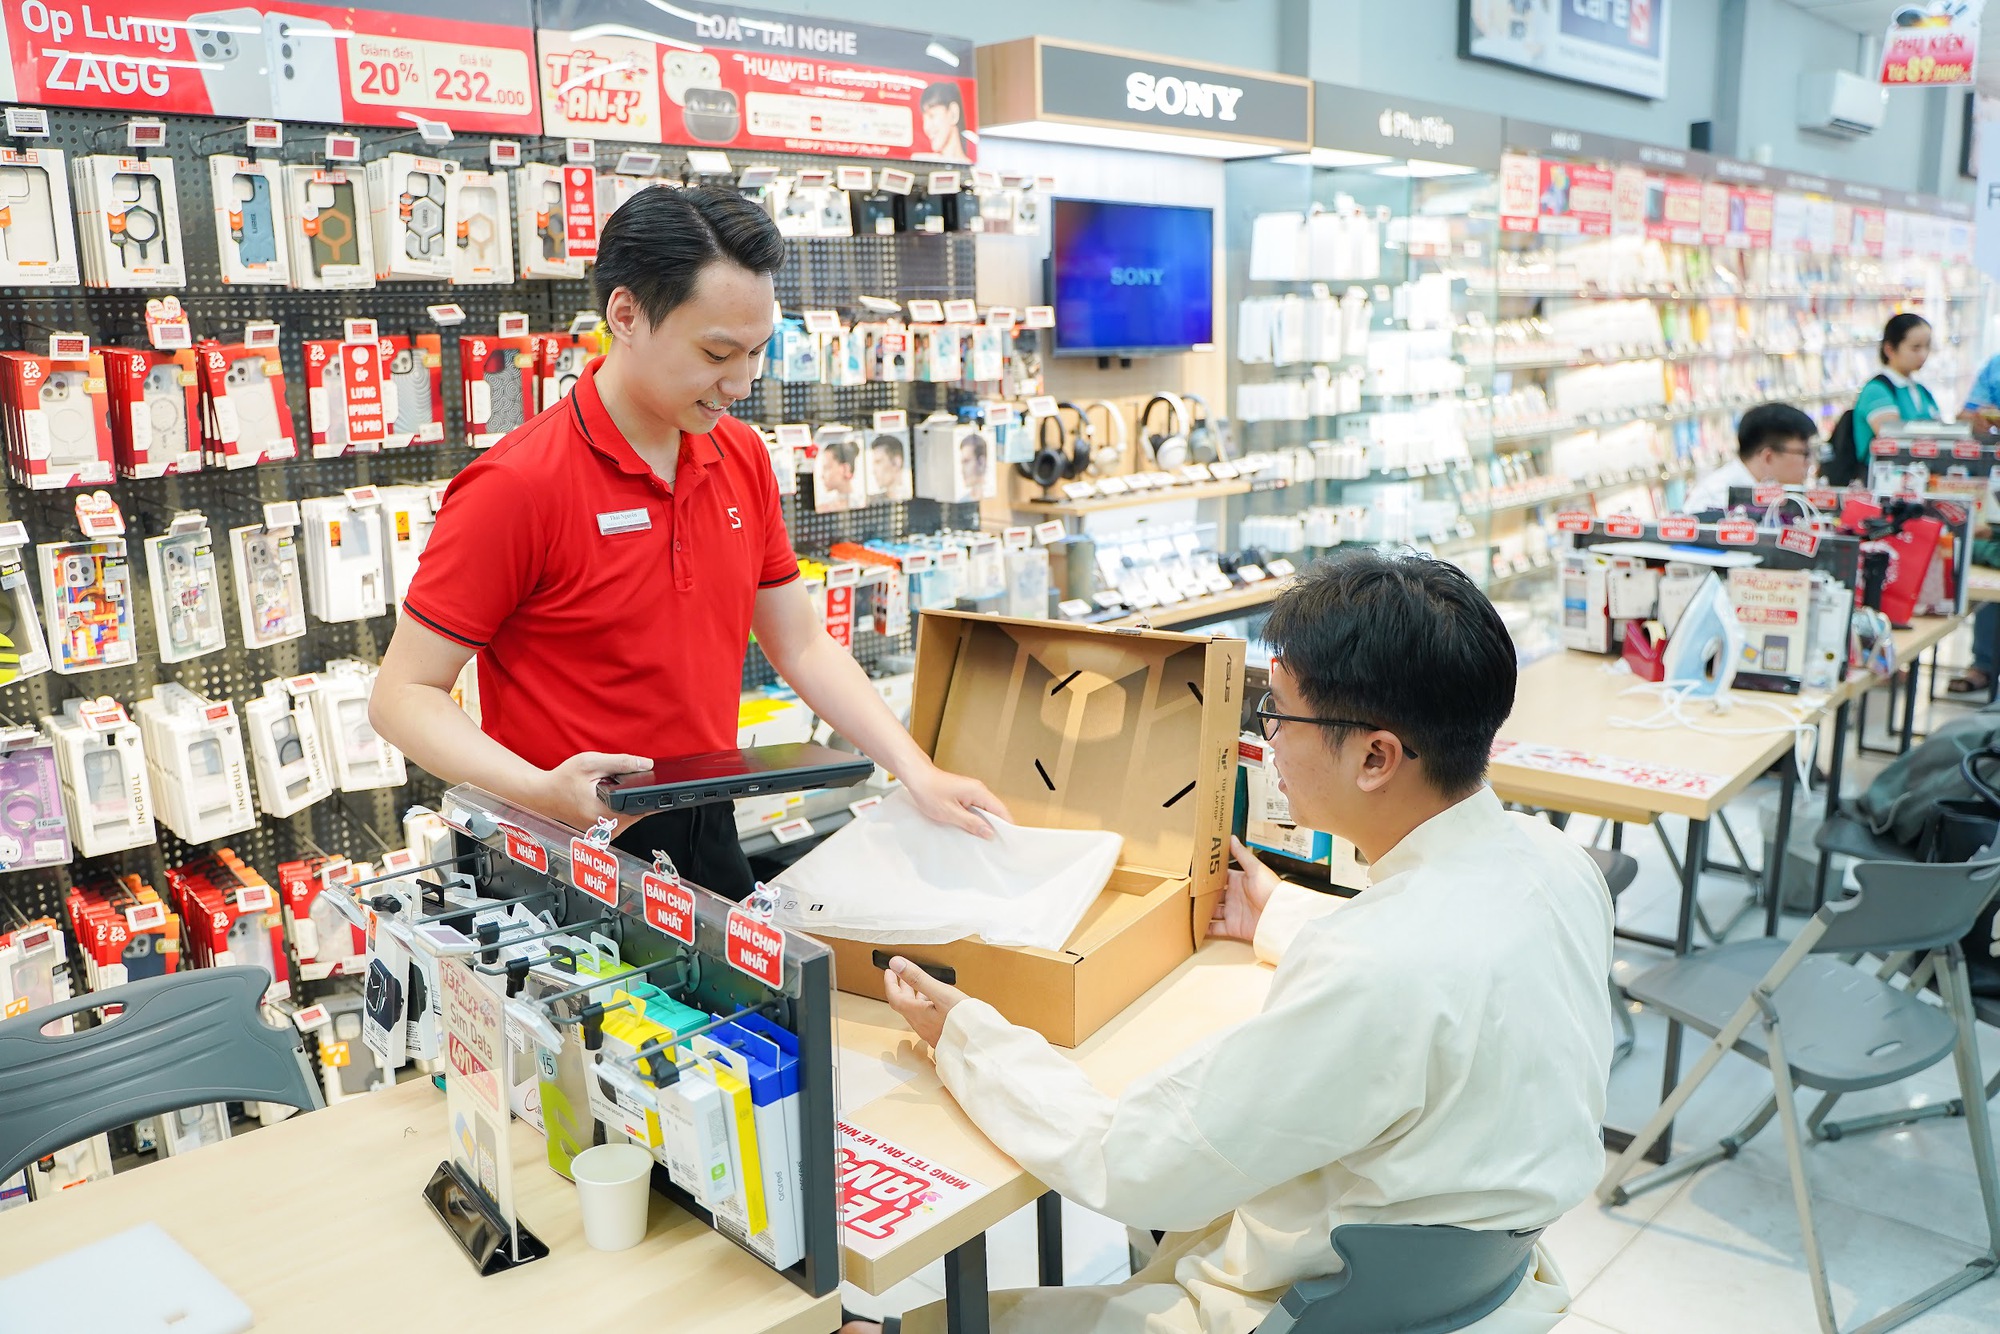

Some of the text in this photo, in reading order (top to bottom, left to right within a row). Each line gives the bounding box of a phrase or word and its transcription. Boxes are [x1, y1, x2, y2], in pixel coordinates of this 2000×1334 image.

[695, 14, 742, 42] LOA
[761, 20, 794, 48] TAI
[799, 26, 858, 55] NGHE
[42, 48, 170, 97] ZAGG
[359, 61, 419, 96] 20%
[743, 57, 815, 82] HUAWEI
[433, 68, 525, 106] 232.000
[1126, 71, 1243, 122] SONY
[1110, 267, 1165, 287] SONY
[349, 403, 382, 417] IPHONE
[352, 420, 382, 433] 16 PRO
[516, 842, 538, 863] NHẤT
[574, 847, 616, 879] BÁN CHẠY
[1209, 836, 1222, 875] A15
[584, 873, 607, 894] NHẤT
[646, 883, 693, 917] BÁN CHẠY
[657, 908, 683, 932] NHẤT
[730, 920, 781, 958] BÁN CHẠY
[741, 948, 769, 974] NHẤT
[450, 1003, 493, 1061] Sim Data
[902, 1156, 930, 1172] TẾT
[929, 1169, 971, 1190] MANG
